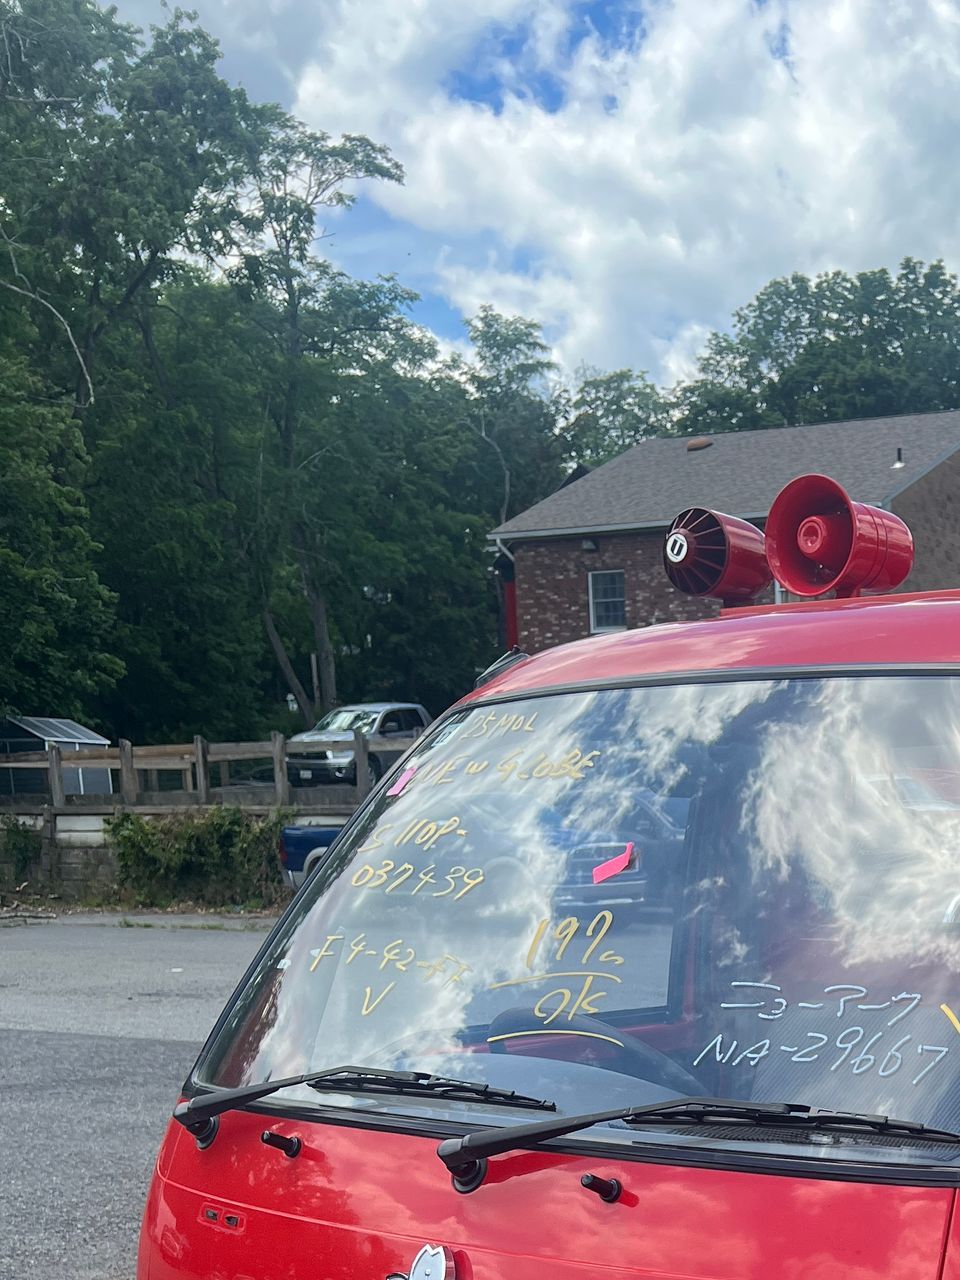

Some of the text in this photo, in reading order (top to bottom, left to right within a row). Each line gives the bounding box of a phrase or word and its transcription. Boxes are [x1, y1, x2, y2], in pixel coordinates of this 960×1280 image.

[351, 860, 484, 901] 037439
[533, 975, 608, 1025] OK
[693, 1027, 949, 1084] NA-29667
